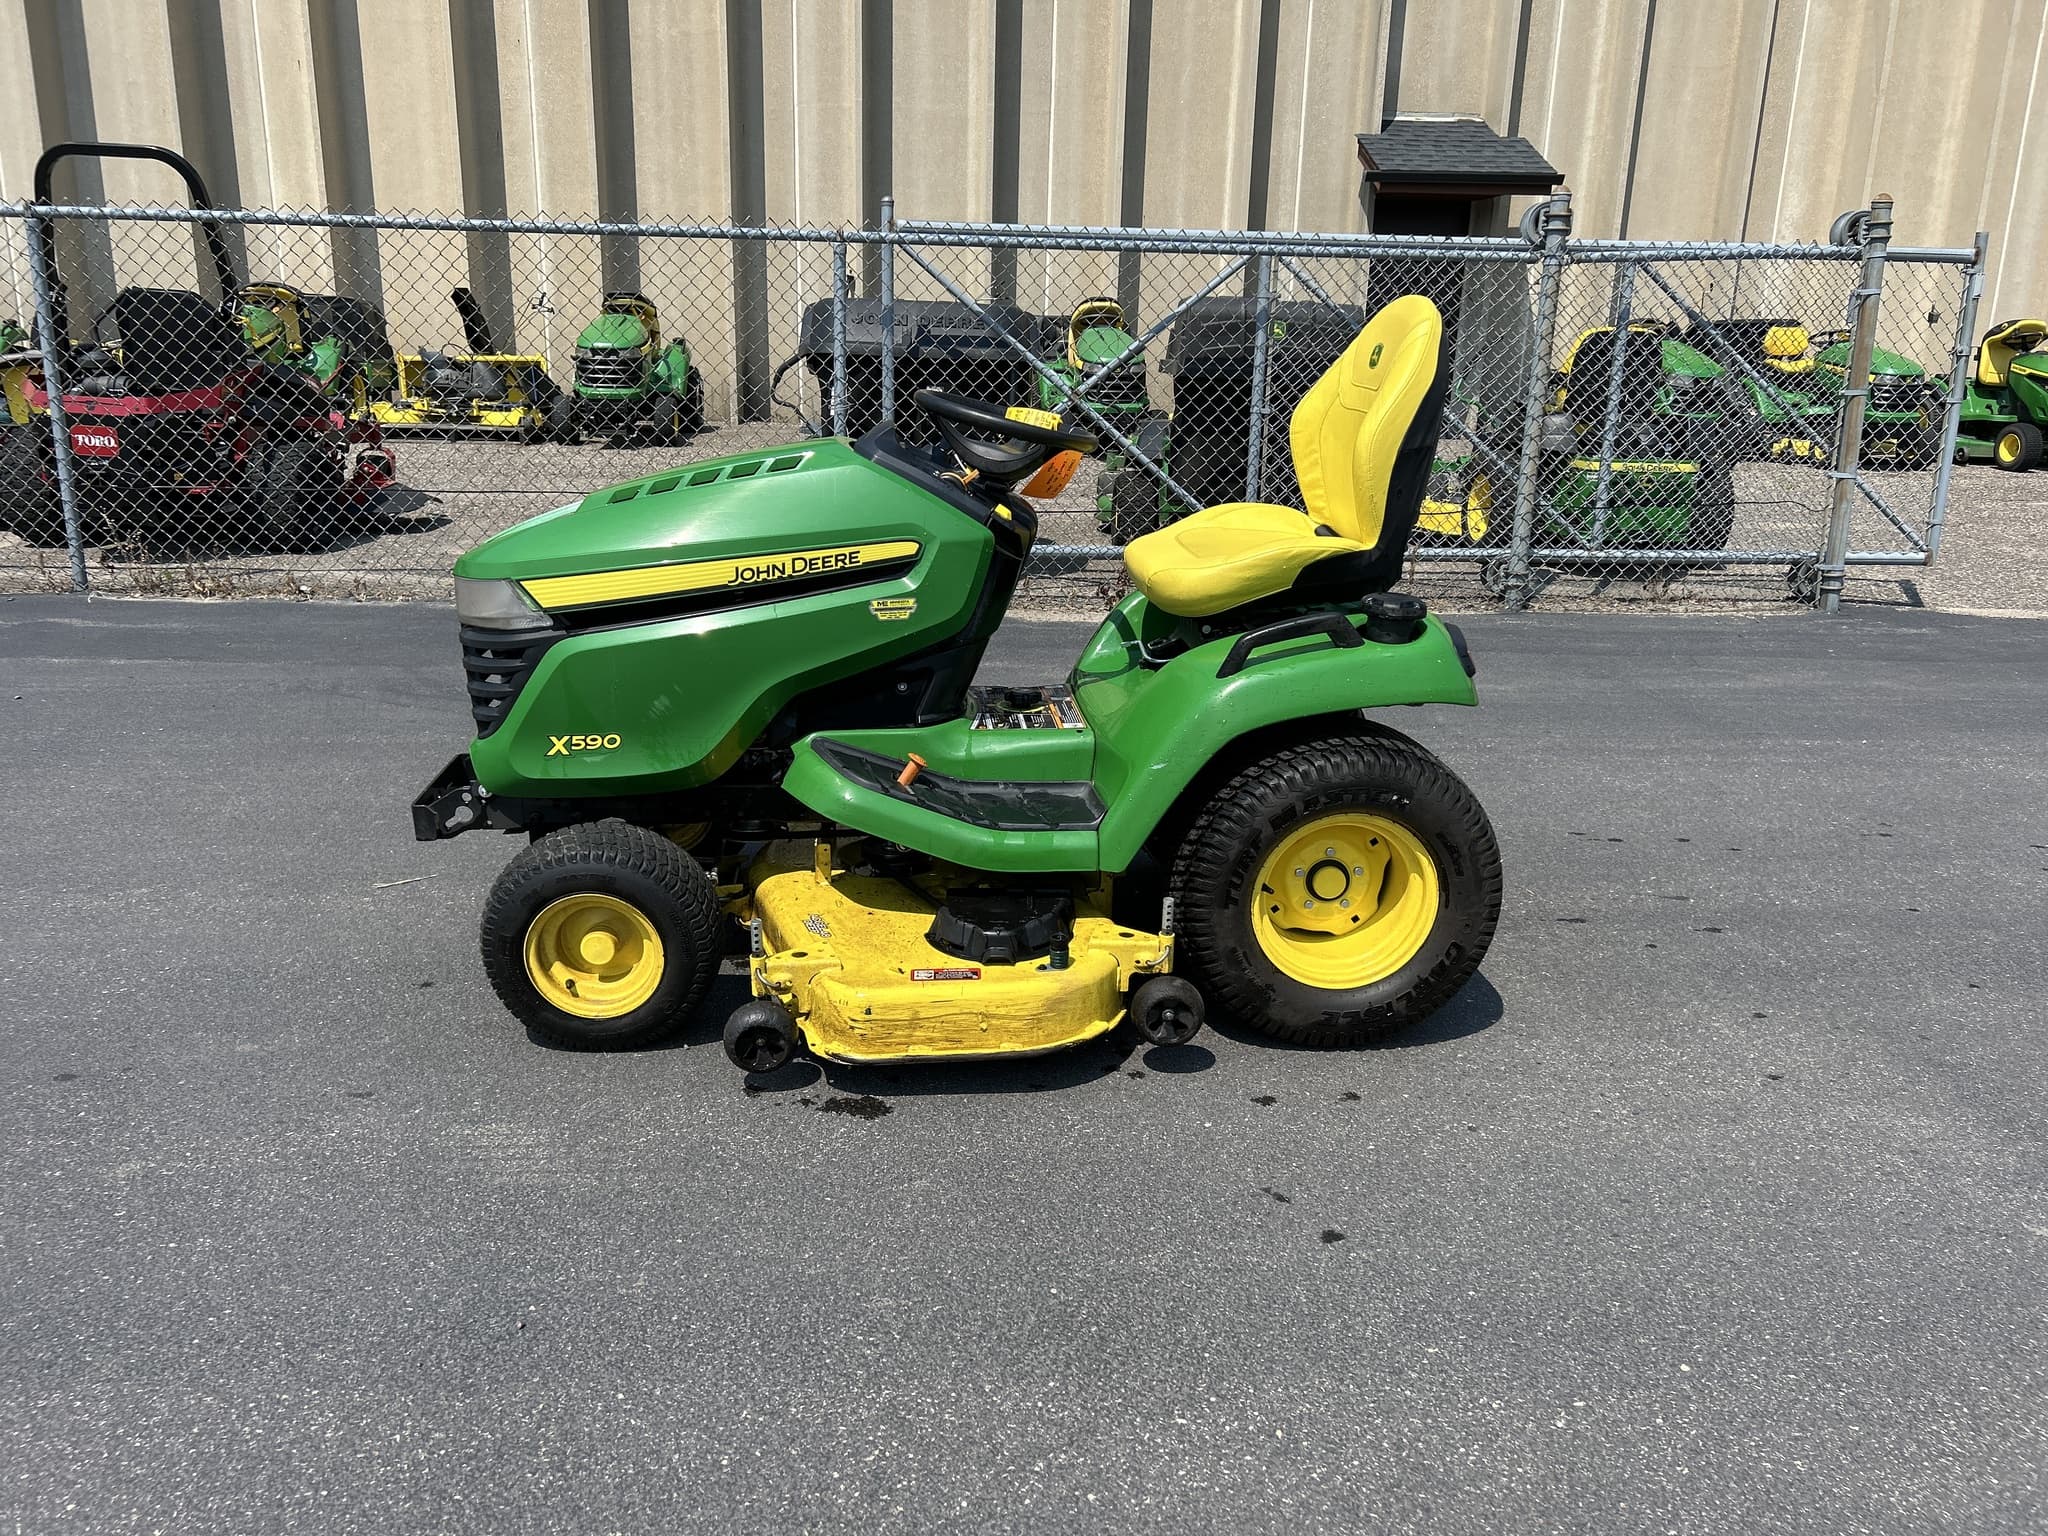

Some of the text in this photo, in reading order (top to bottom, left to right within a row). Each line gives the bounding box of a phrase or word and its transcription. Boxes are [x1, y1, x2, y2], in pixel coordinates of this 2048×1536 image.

[851, 312, 909, 328] JON
[728, 551, 861, 584] JOHN DEERE
[545, 733, 622, 756] X590
